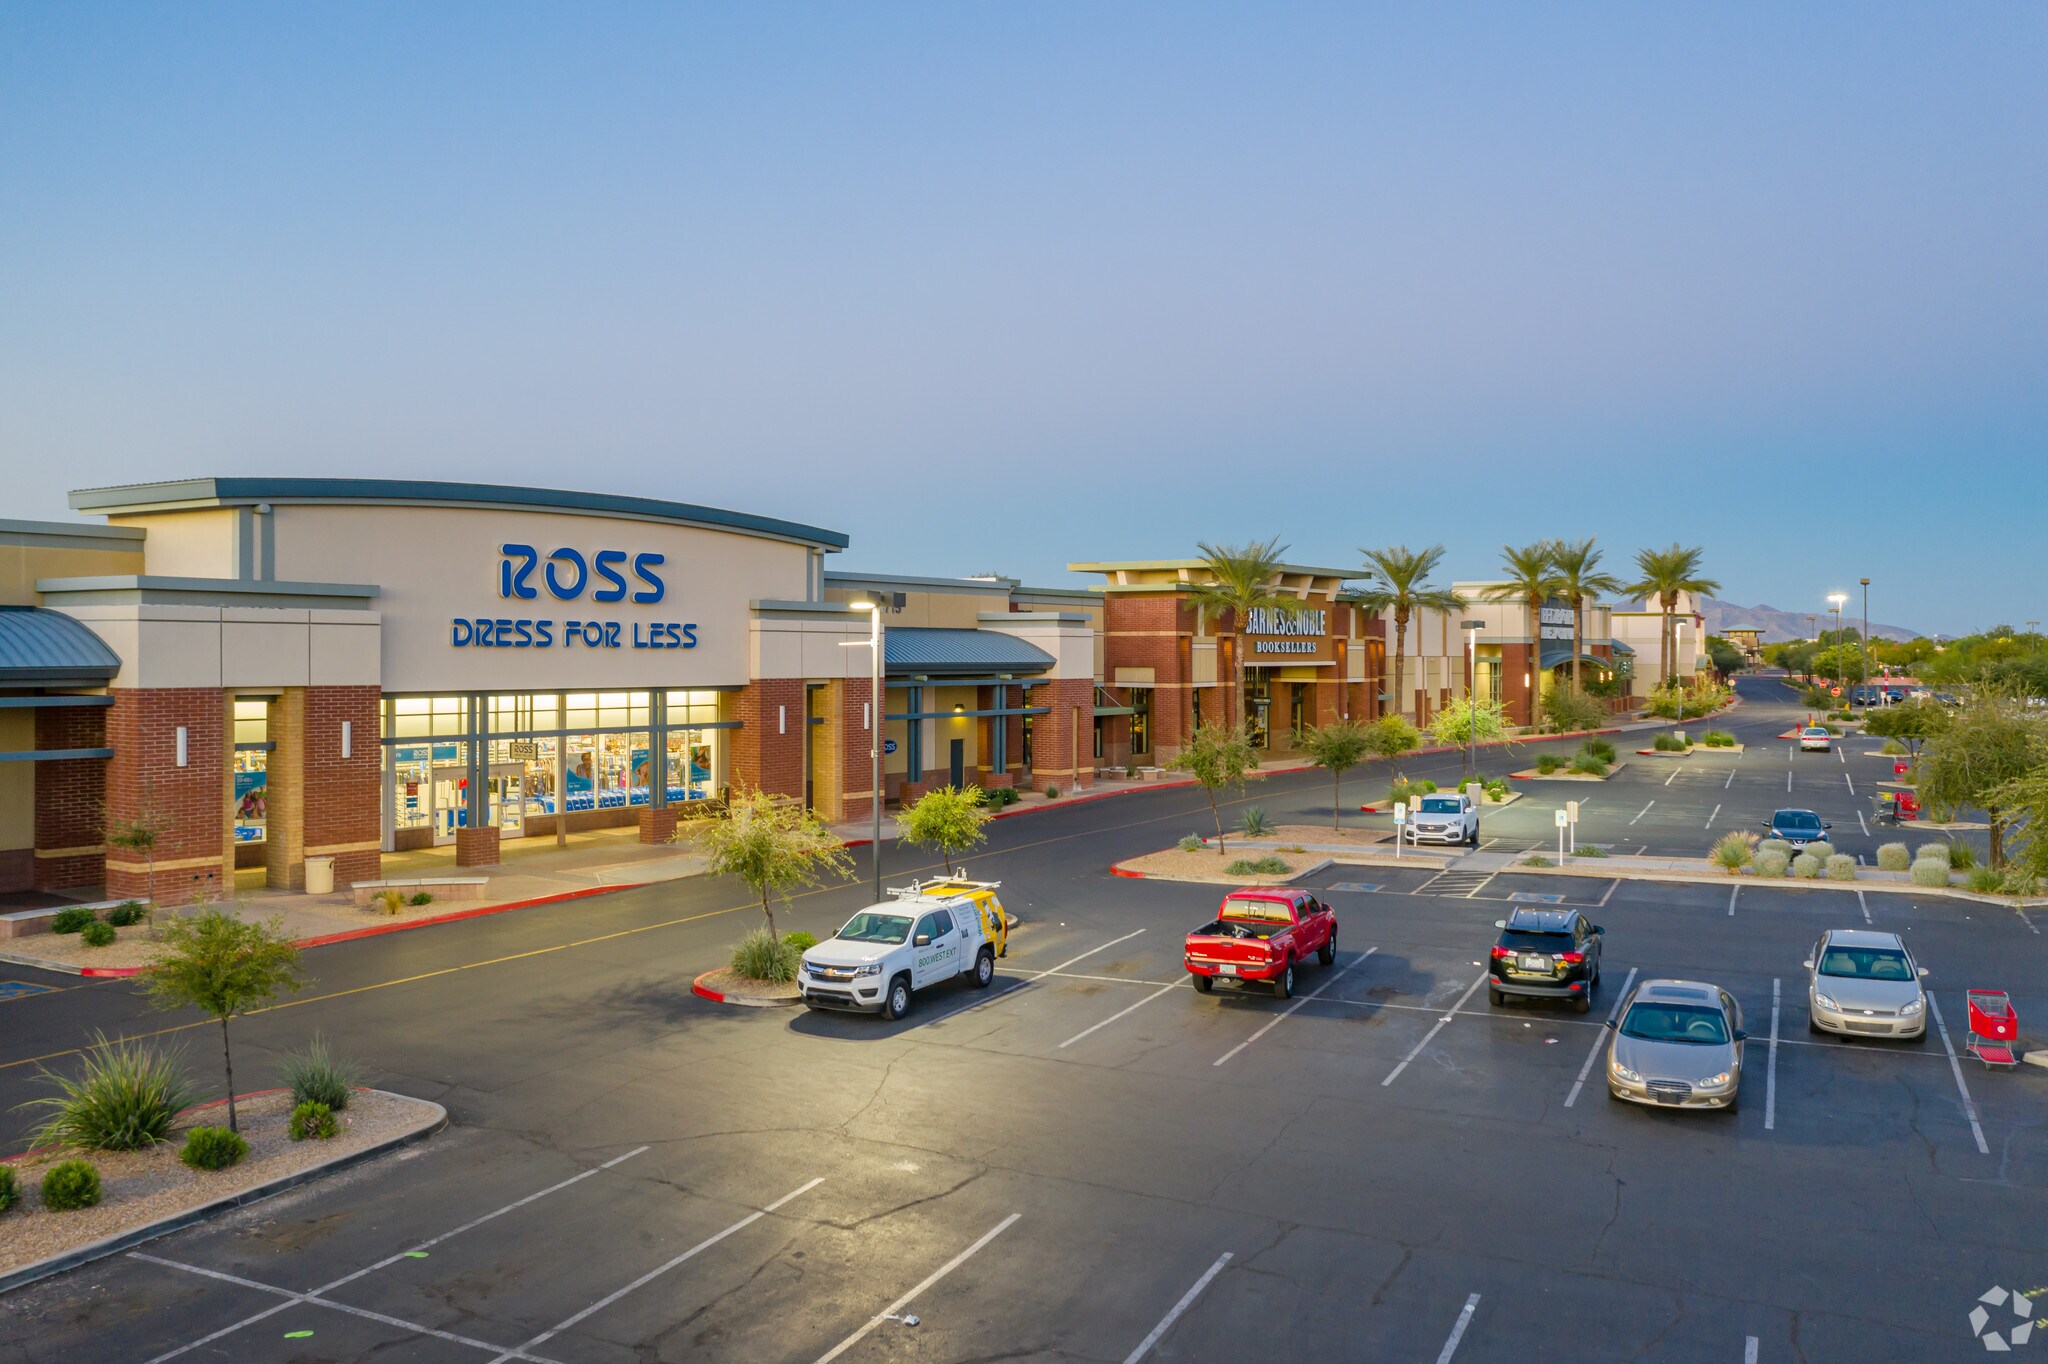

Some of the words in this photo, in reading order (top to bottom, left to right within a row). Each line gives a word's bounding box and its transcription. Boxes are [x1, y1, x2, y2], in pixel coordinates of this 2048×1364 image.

[499, 543, 665, 603] ROSS
[451, 618, 553, 648] DRESS
[564, 620, 621, 648] FOR
[632, 622, 698, 649] LESS
[1256, 641, 1317, 653] BOOKSELLERS
[514, 744, 533, 754] ROSS
